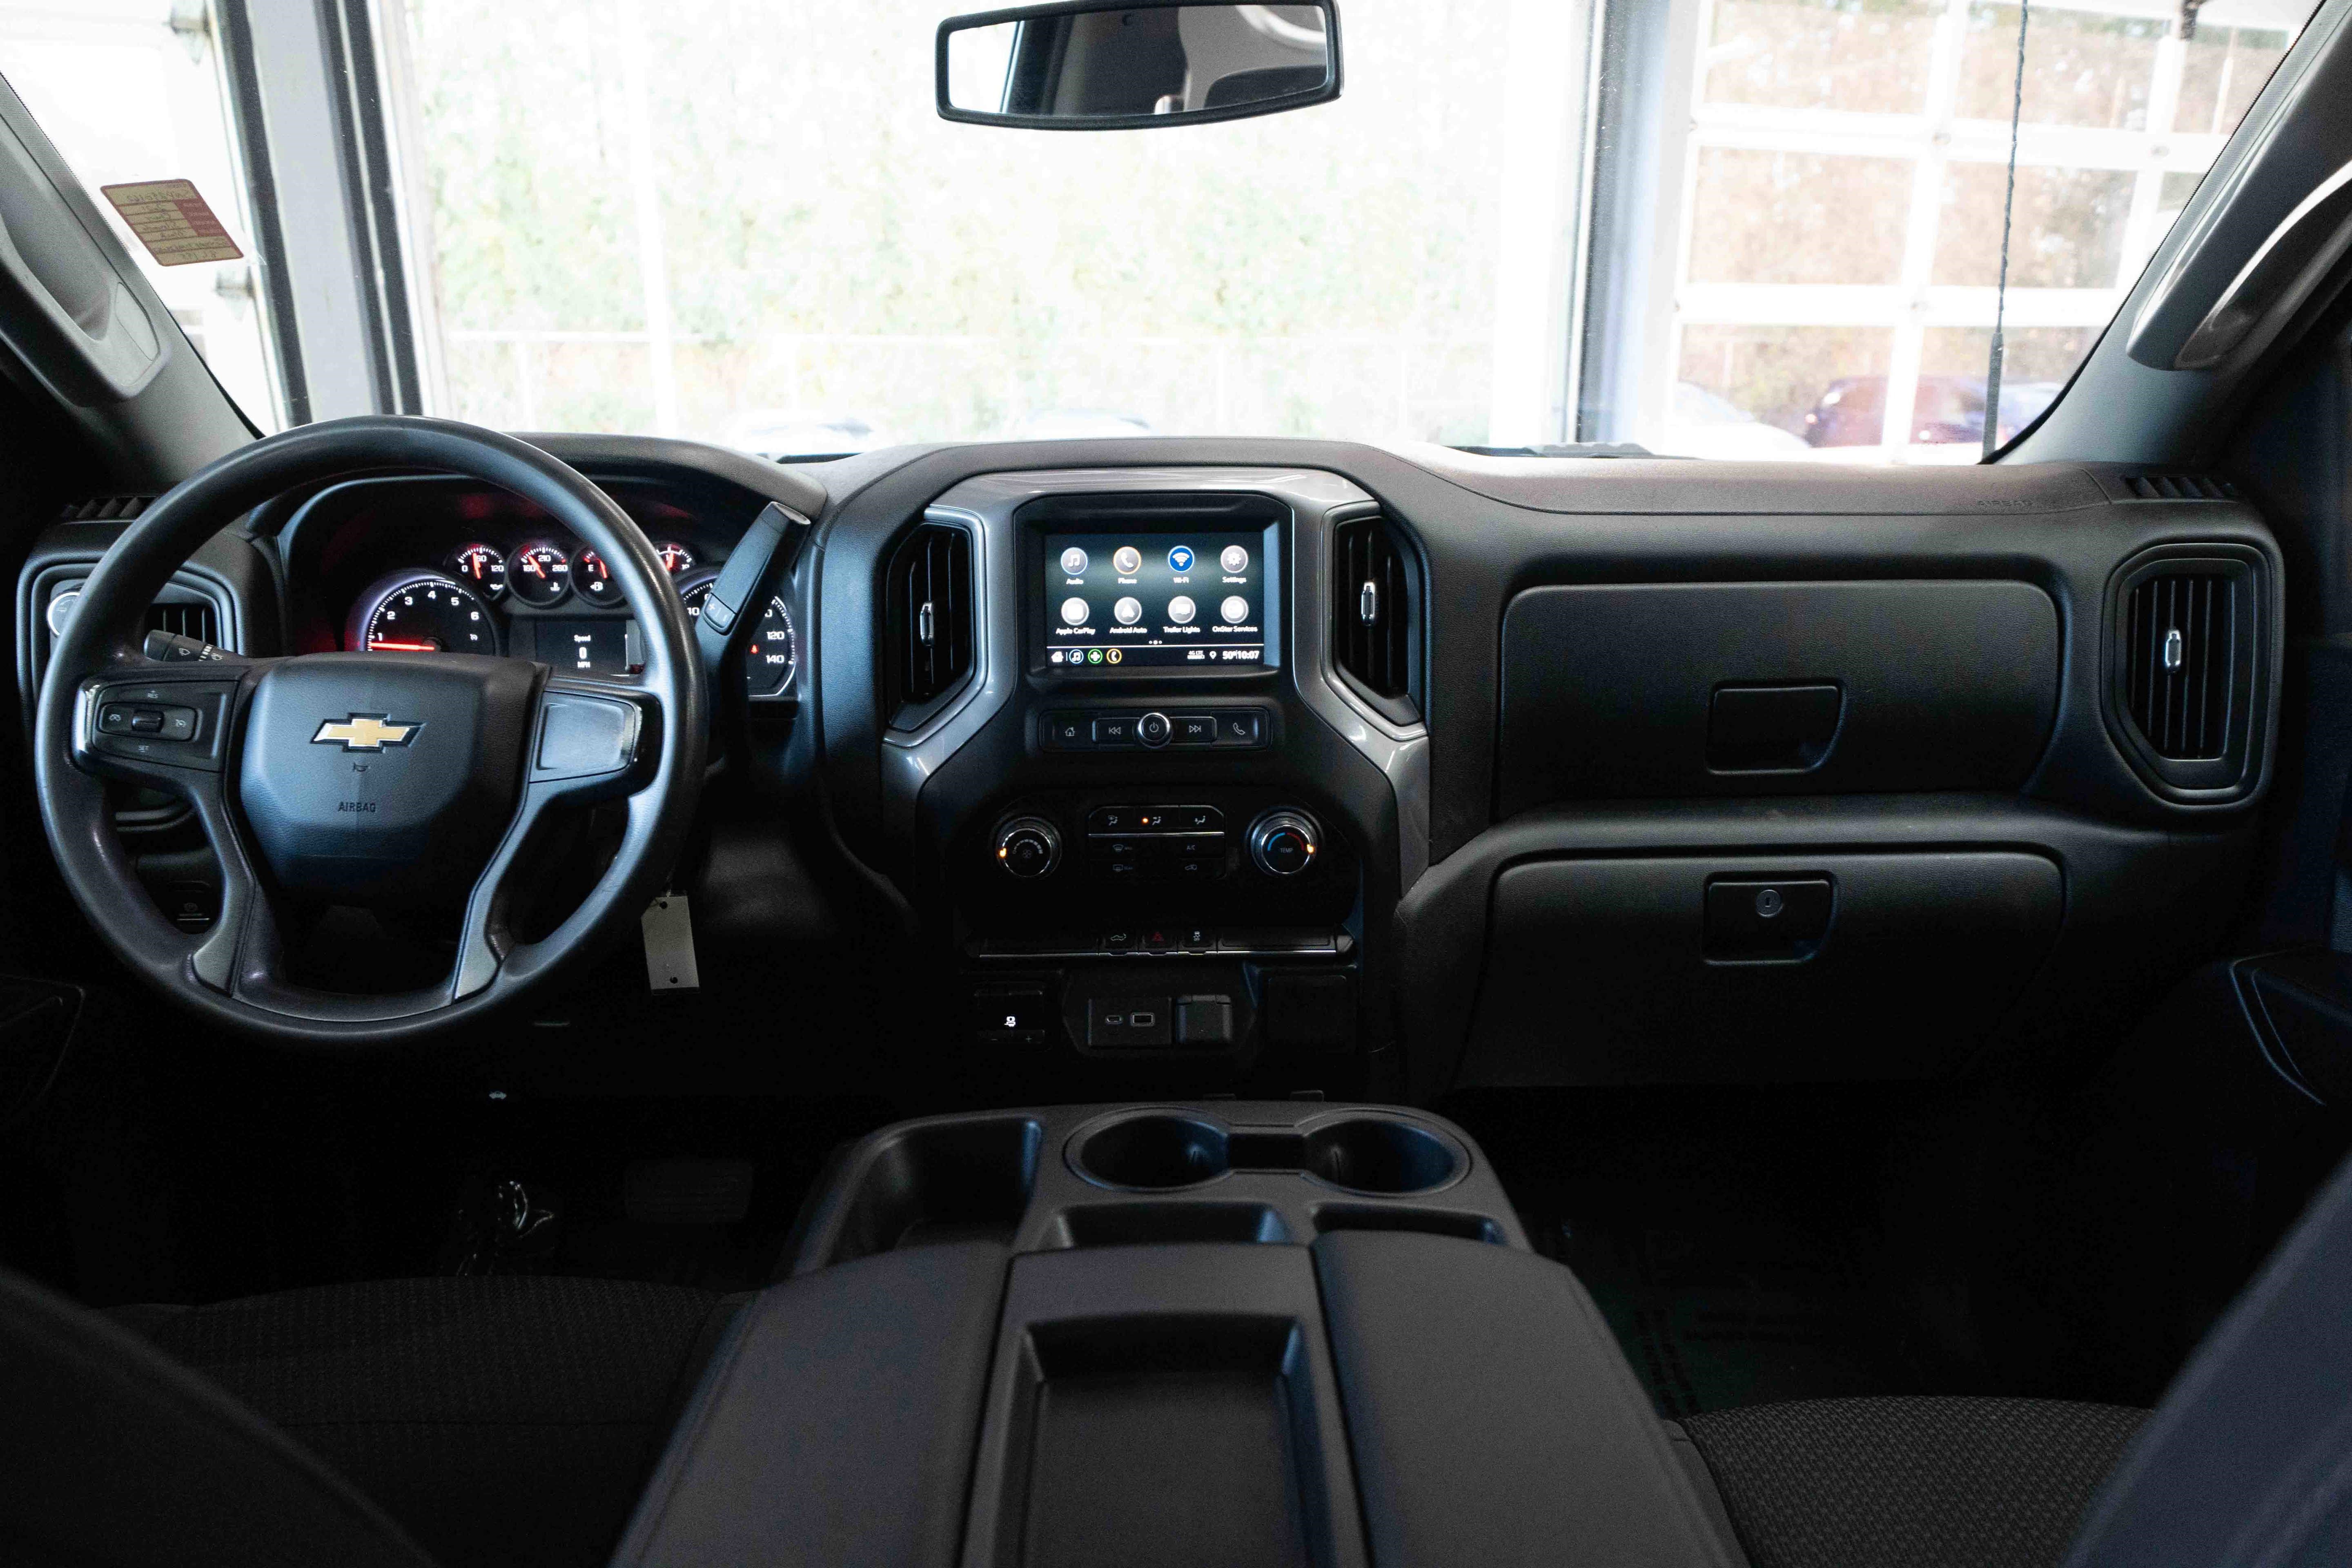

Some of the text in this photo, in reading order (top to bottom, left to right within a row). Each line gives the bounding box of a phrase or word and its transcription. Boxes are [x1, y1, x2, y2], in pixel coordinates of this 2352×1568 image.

[428, 590, 436, 599] 4
[405, 597, 413, 605] 3
[451, 597, 459, 606] 5
[387, 611, 395, 619] 2
[471, 612, 479, 620] 6
[377, 633, 383, 641] 1
[766, 631, 784, 640] 120
[579, 647, 587, 659] 0
[766, 655, 784, 664] 140
[338, 802, 376, 812] AIRBAG
